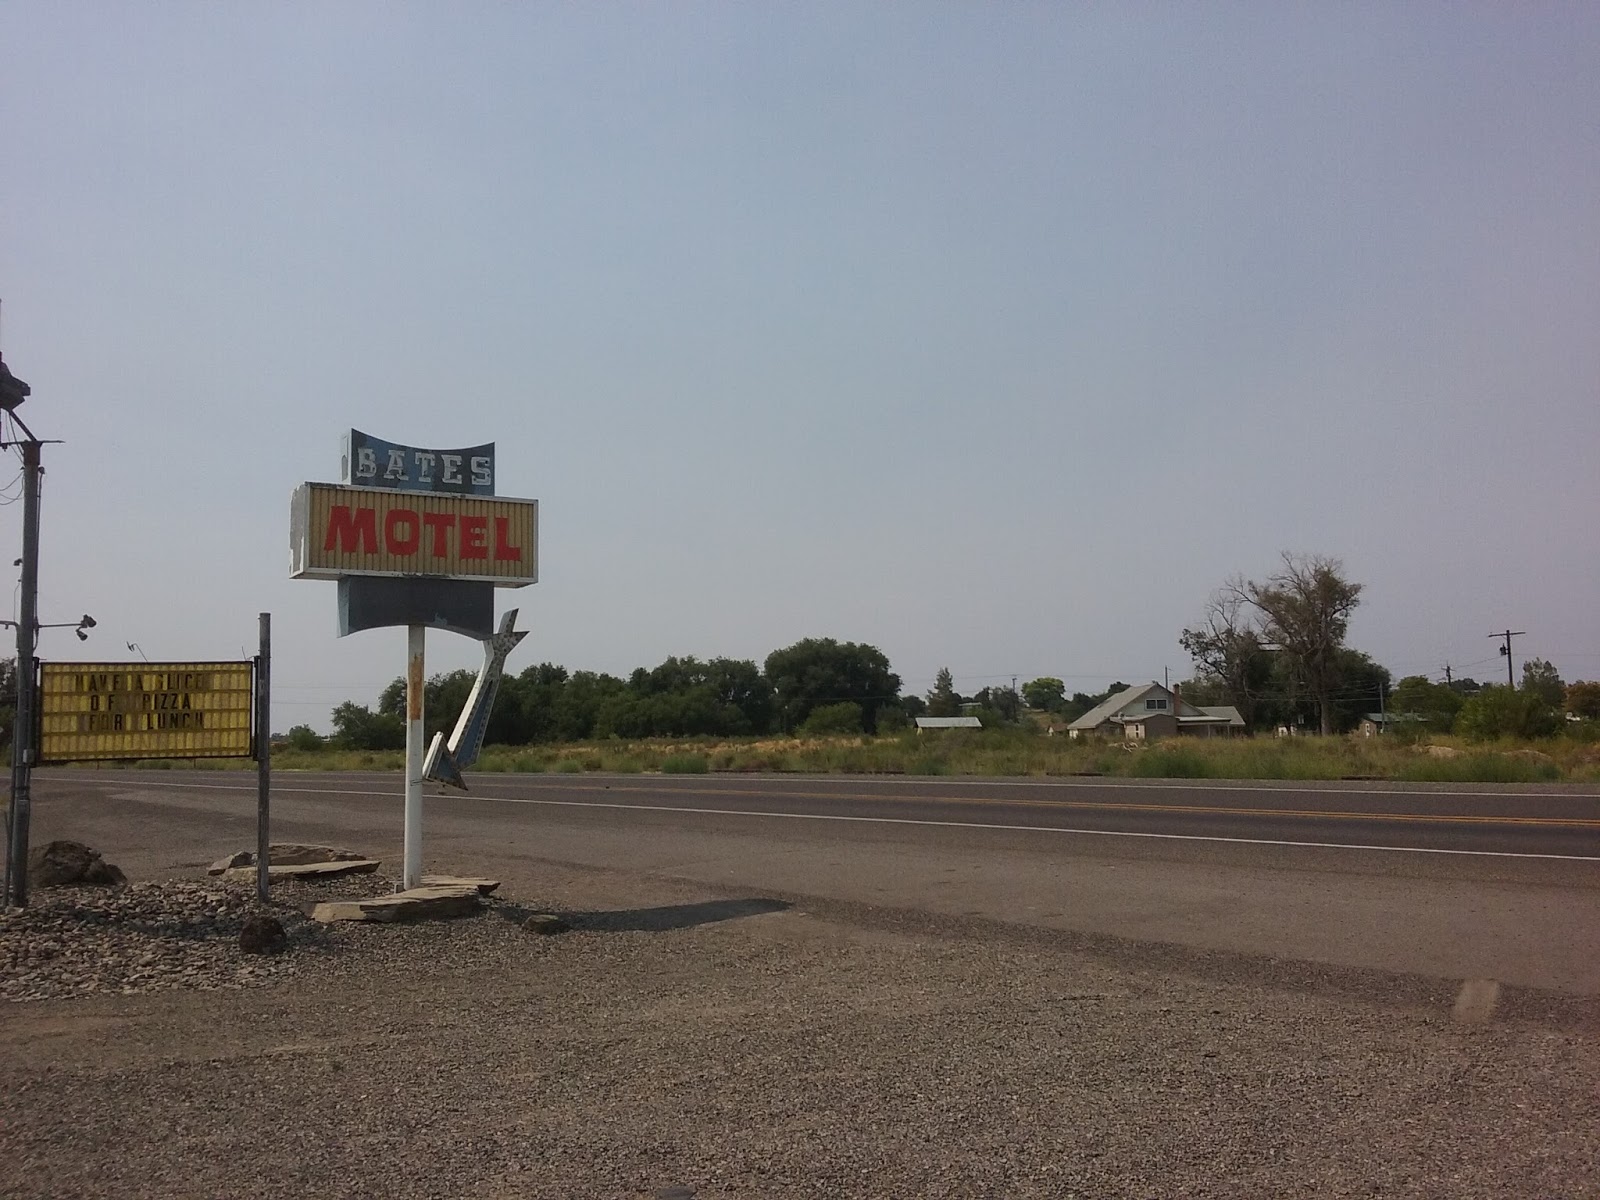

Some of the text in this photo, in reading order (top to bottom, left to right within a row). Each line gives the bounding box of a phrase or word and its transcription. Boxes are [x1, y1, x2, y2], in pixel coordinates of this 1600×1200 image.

[356, 447, 492, 485] BATES
[324, 505, 521, 561] MOTEL
[75, 673, 203, 692] HAVE A SLICE
[90, 693, 191, 711] OF PIZZA
[89, 712, 204, 731] FOR LUNCH
